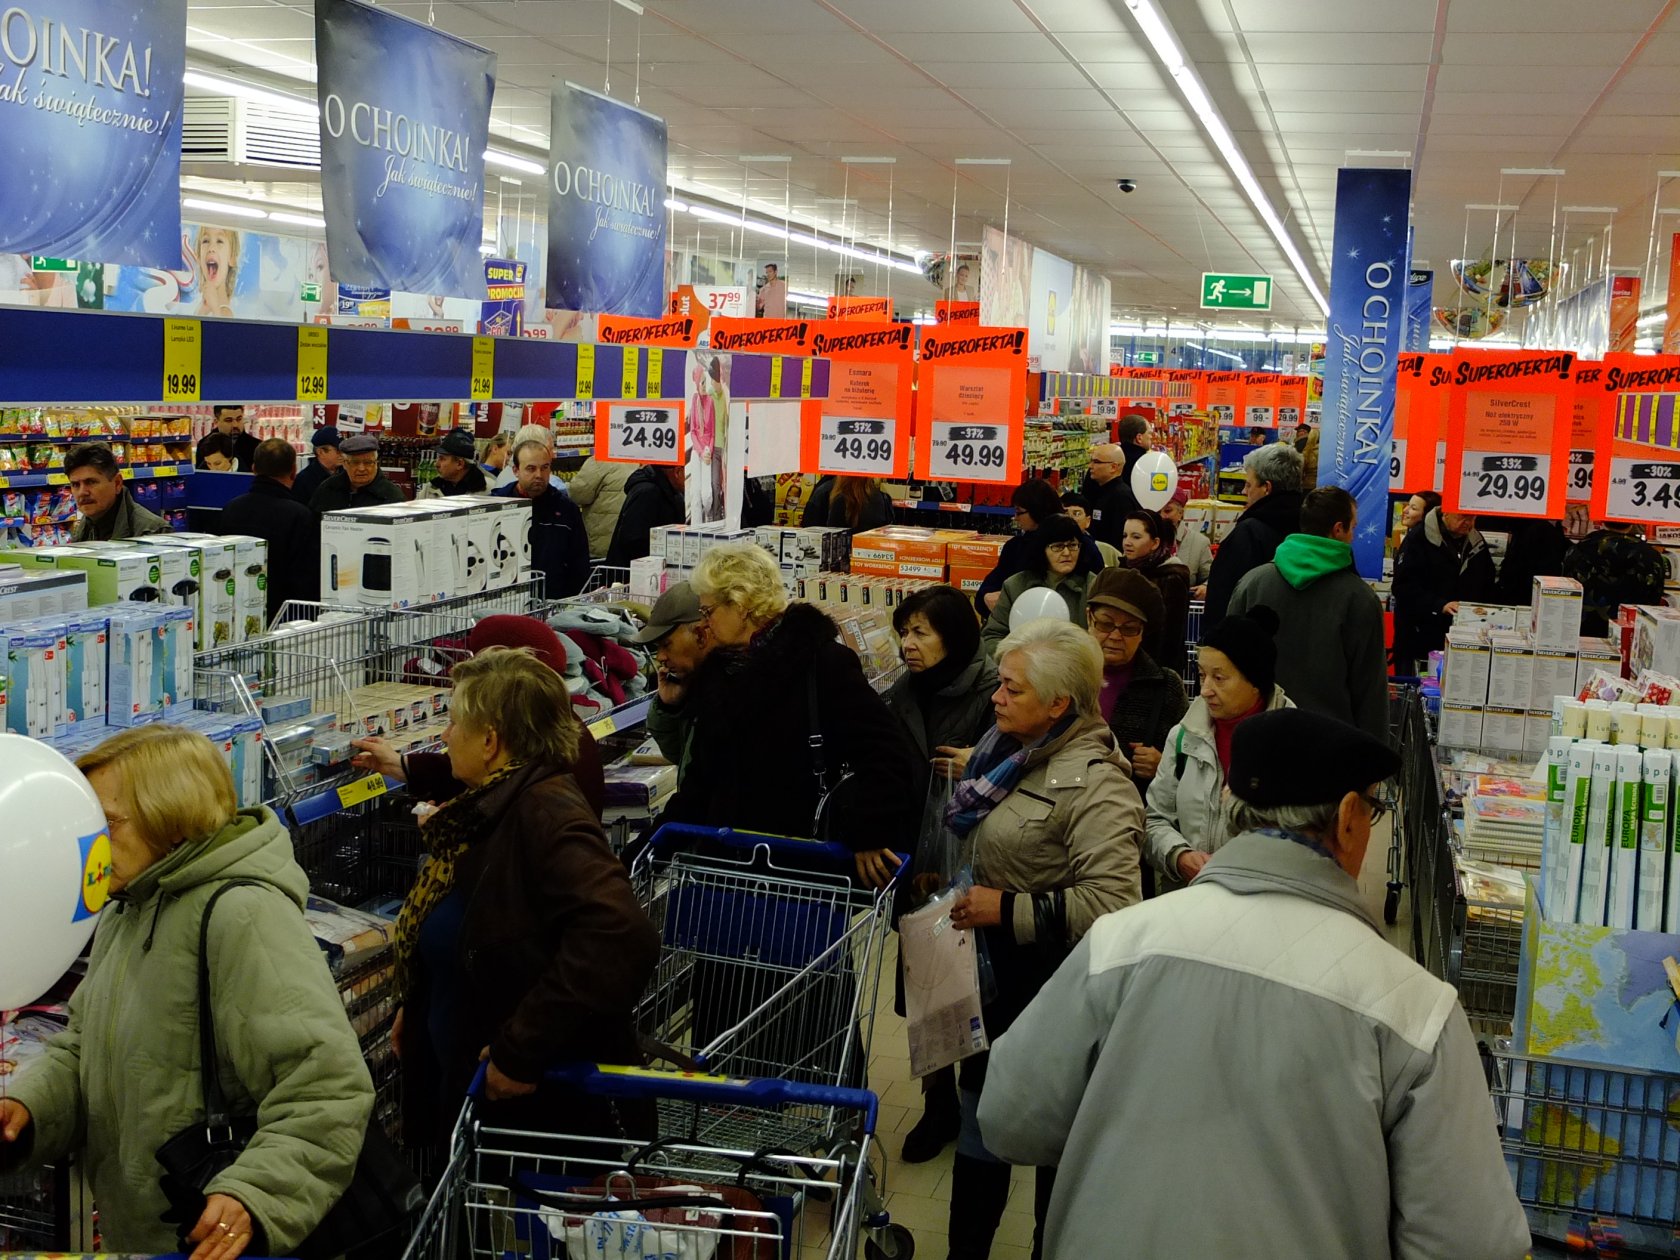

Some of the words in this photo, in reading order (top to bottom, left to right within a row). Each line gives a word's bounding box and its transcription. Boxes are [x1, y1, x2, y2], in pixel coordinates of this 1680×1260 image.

[0, 63, 29, 105] ak
[33, 79, 171, 136] świątecznie!
[325, 94, 346, 138] O
[351, 102, 470, 173] CHOINKA!
[377, 155, 406, 197] Jak
[408, 164, 478, 201] świątecznie!
[555, 161, 571, 195] O
[575, 166, 655, 217] CHOINKA!
[590, 206, 610, 241] Jak
[487, 267, 514, 281] SUPER
[1365, 262, 1392, 289] O
[828, 299, 888, 319] SUPEROFERTA!
[602, 318, 693, 344] SUPEROFERTA!
[712, 322, 808, 350] SUPEROFERTA!
[812, 326, 911, 356] SUPEROFERTA!
[922, 330, 1025, 361] SUPEROFERTA!
[1334, 324, 1360, 367] Jak
[1206, 372, 1241, 384] TANIEJ!
[1244, 374, 1280, 386] TANIEJ!
[1352, 295, 1390, 465] CHOINKA!
[1455, 353, 1573, 386] SUPEROFERTA!
[168, 373, 196, 394] 19.99
[301, 375, 324, 394] 12.99
[635, 411, 657, 422] -37%
[1490, 399, 1531, 408] SilverCrest
[849, 422, 872, 433] -37%
[960, 428, 984, 439] -37%
[1334, 367, 1356, 480] świątecznie!
[622, 425, 676, 449] 24.99
[834, 437, 892, 461] 49.99
[945, 443, 1005, 468] 49.99
[1495, 458, 1522, 470] -33%
[1644, 466, 1672, 477] -30%
[1476, 472, 1545, 501] 29.99
[1571, 805, 1582, 843] EUROPA
[1621, 809, 1631, 849] EUROPA
